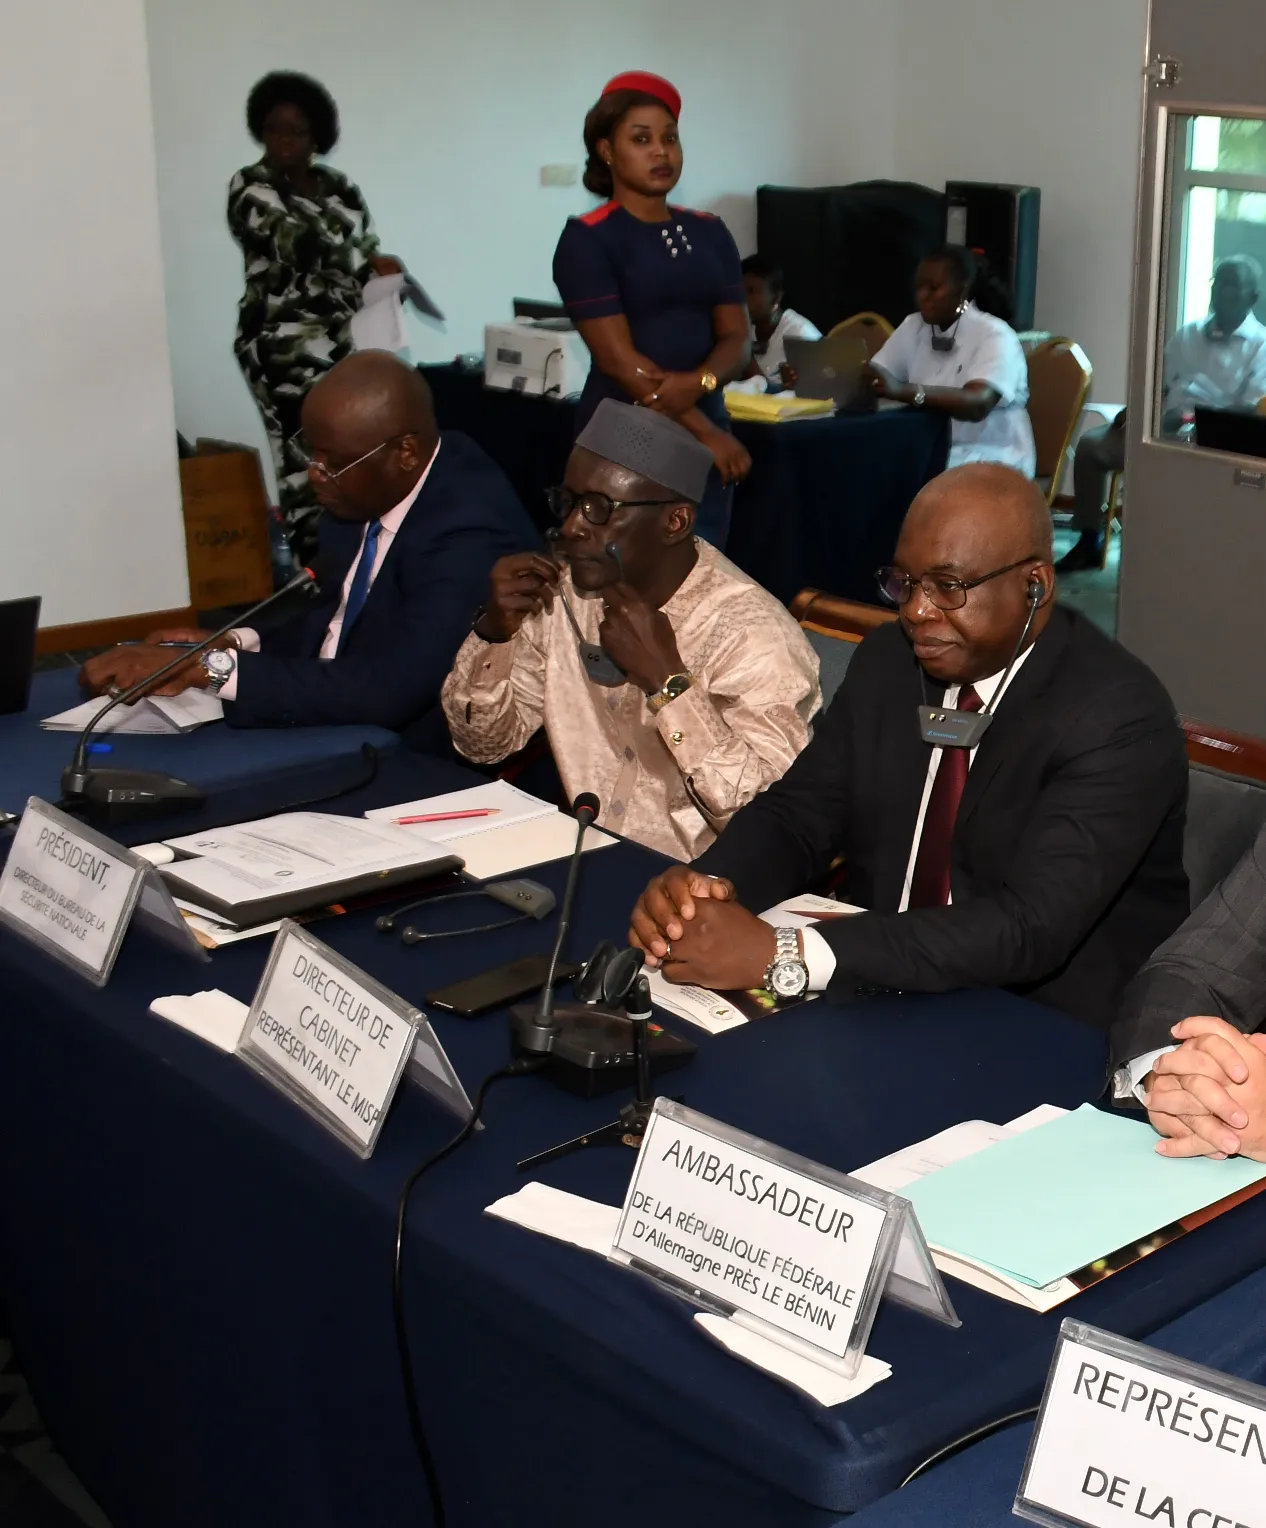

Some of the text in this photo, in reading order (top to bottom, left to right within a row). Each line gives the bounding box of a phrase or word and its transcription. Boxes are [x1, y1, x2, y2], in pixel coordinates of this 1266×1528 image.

[36, 827, 111, 890] PRÉSIDENT,
[13, 866, 106, 932] DIRECTEUR DU BUREAU DE LA
[49, 908, 87, 940] NATIONALE
[292, 954, 394, 1049] DIRECTEUR DE
[299, 1005, 361, 1068] CABINET
[256, 1010, 380, 1126] REPRÉSENTANT LE MISP
[661, 1139, 855, 1243] AMBASSADEUR
[631, 1190, 856, 1309] DE LA RÉPUBLIQUE FÉDÉRALE
[632, 1220, 837, 1331] D'Allemagne PRÈS LE BÉNIN
[1081, 1465, 1130, 1508] DE
[1134, 1486, 1175, 1528] LA
